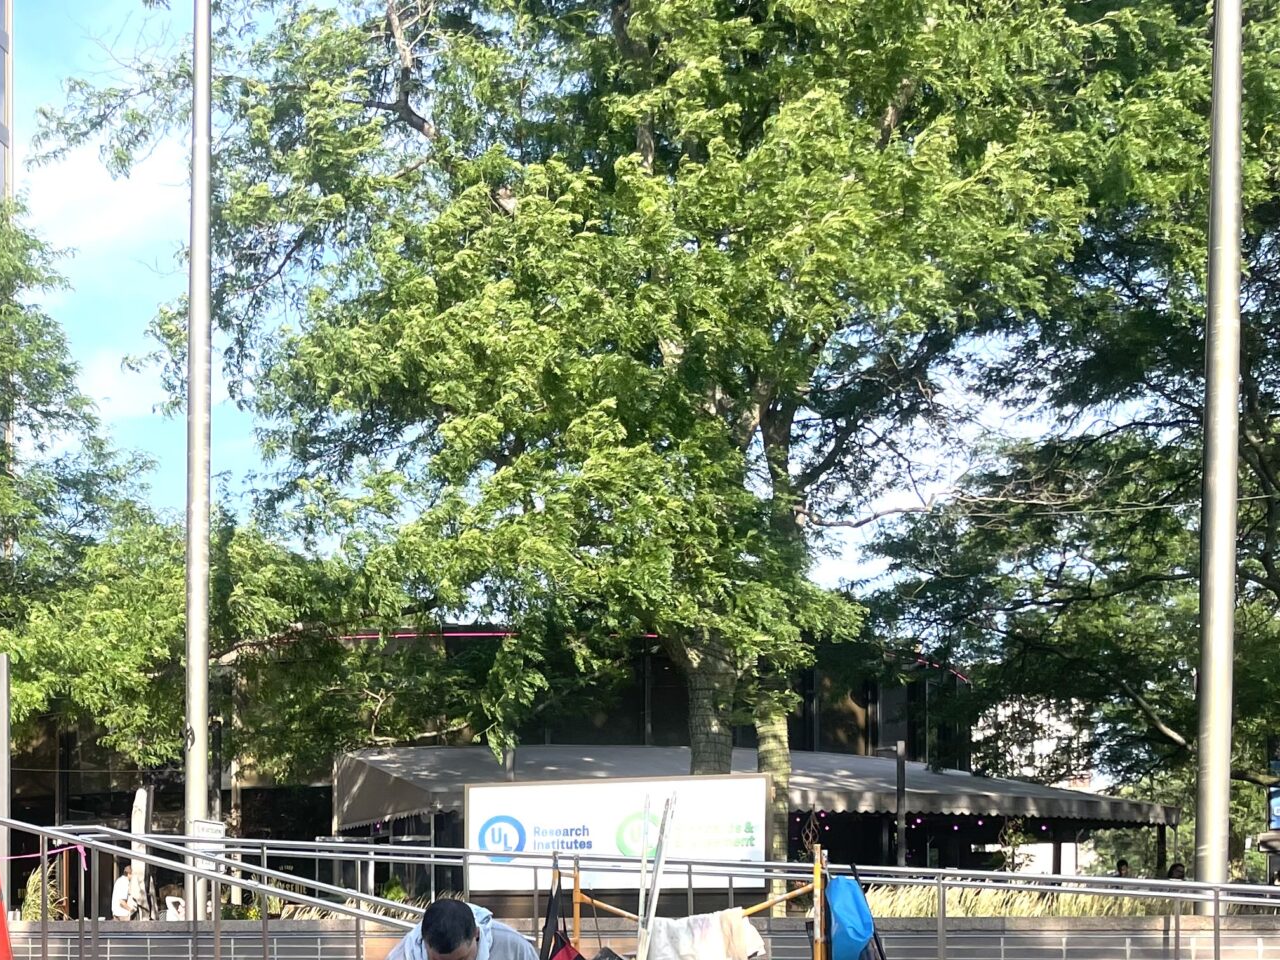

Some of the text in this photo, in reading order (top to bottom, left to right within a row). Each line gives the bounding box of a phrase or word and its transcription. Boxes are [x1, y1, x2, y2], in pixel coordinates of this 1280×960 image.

[533, 824, 590, 837] Research
[491, 827, 513, 851] UL
[533, 839, 593, 850] Institutes
